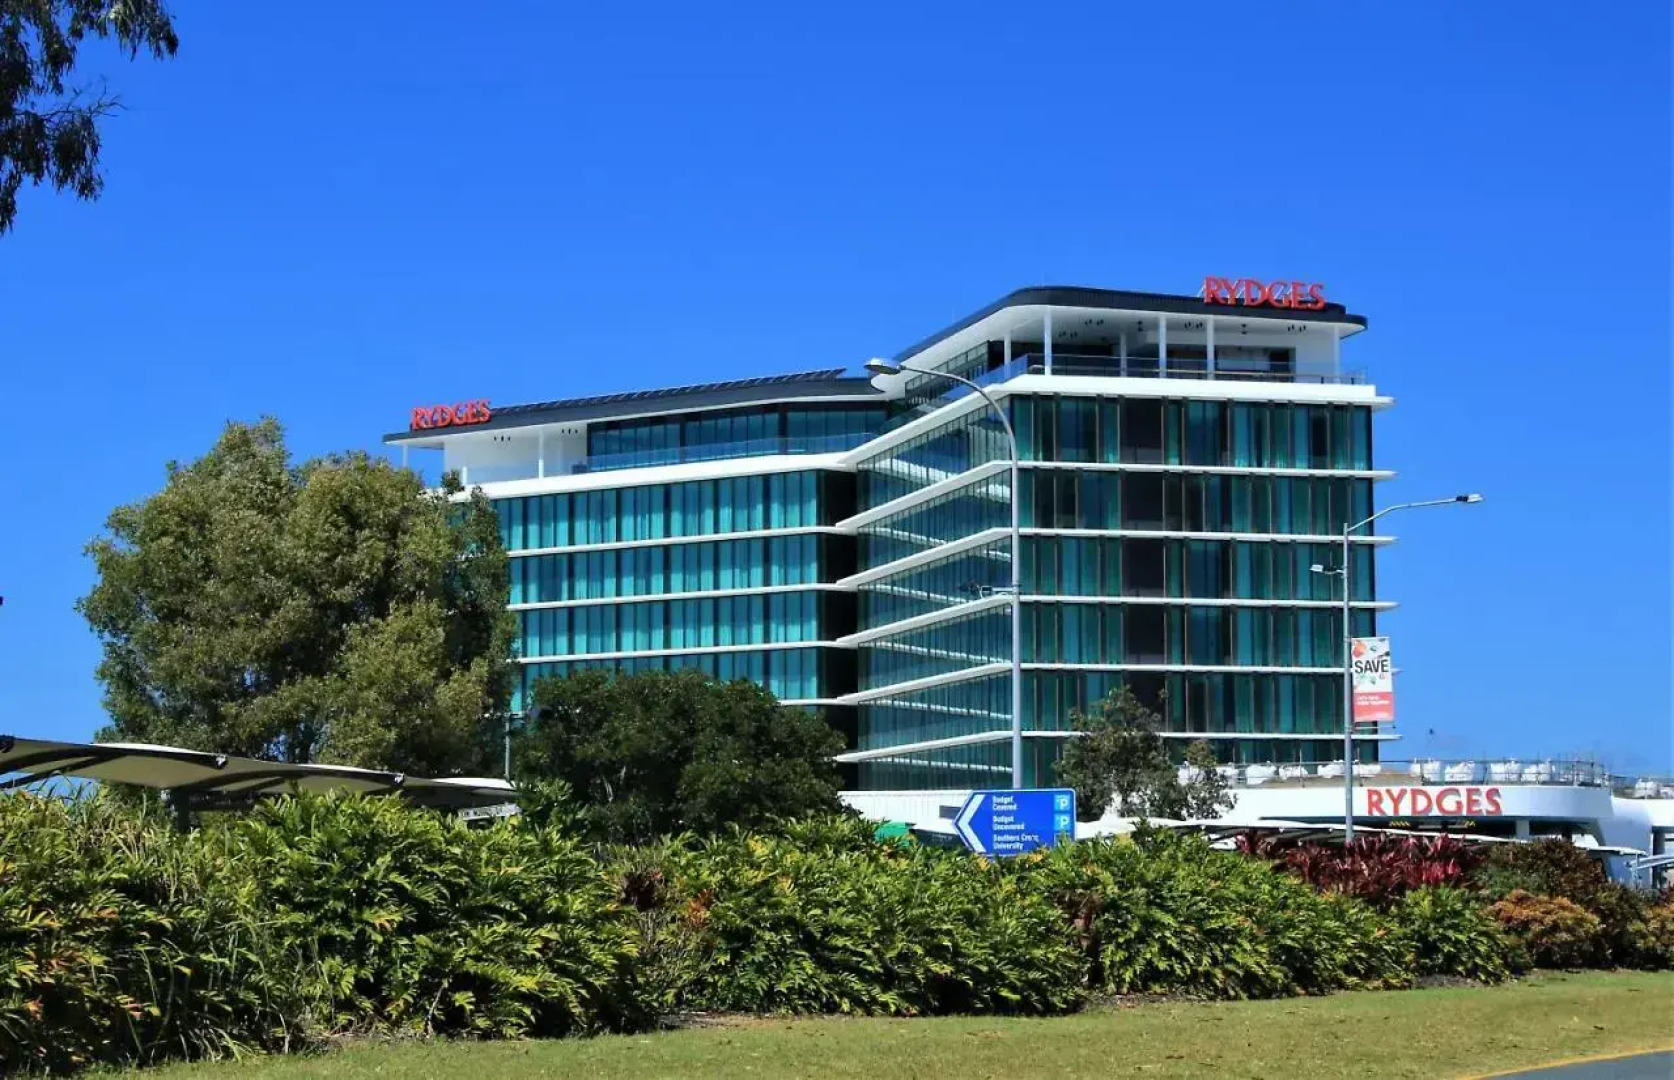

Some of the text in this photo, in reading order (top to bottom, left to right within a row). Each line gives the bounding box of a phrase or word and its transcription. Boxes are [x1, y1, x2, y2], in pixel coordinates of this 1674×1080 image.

[1203, 276, 1325, 310] RYDGES
[411, 399, 491, 430] RYDGES
[1354, 659, 1390, 673] SAVE
[1367, 787, 1503, 816] RYDGES
